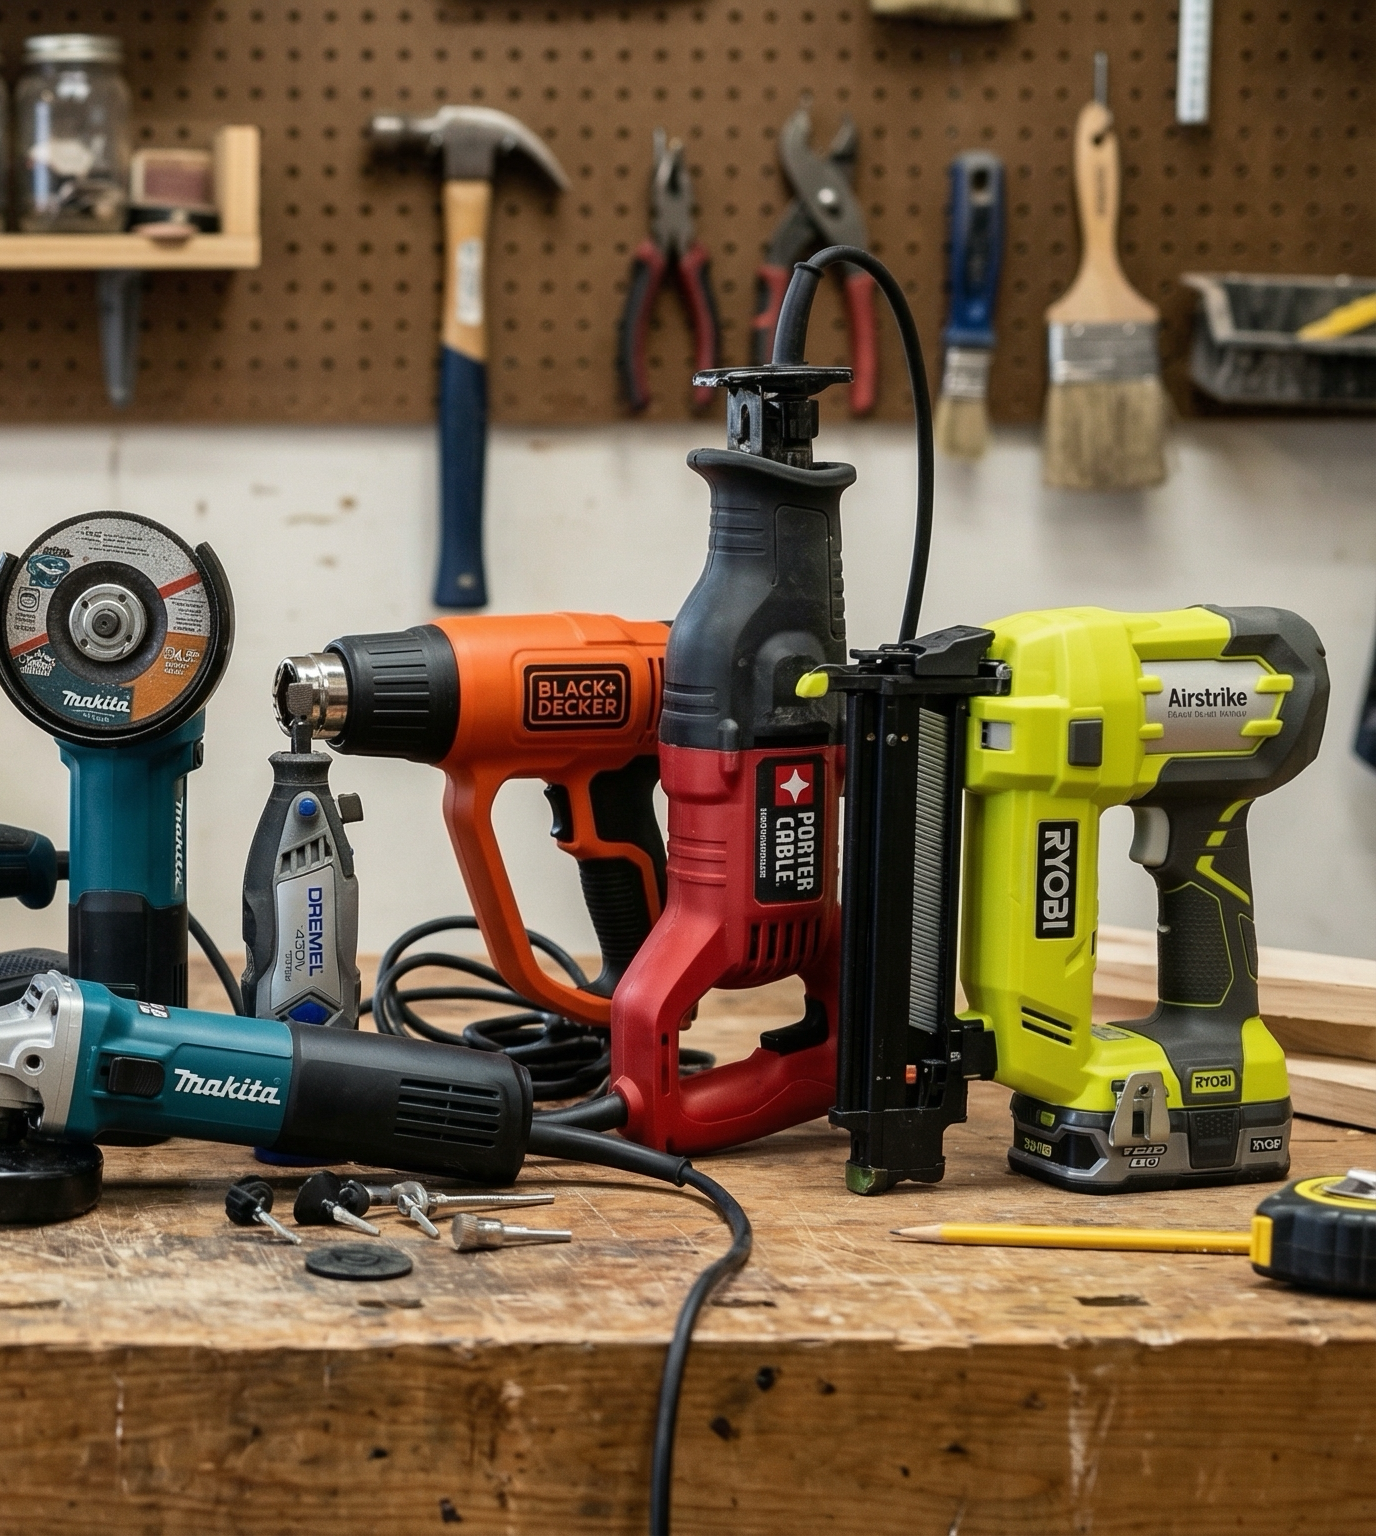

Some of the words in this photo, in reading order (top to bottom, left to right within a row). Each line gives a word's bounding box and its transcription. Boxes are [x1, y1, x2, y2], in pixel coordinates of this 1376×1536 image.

[538, 680, 617, 698] BLACK+
[1168, 687, 1248, 708] Airstrike
[538, 698, 617, 716] DECKER
[797, 811, 815, 891] PORTER
[1042, 828, 1071, 931] RYOBI
[308, 887, 324, 977] DREMEL
[174, 1068, 281, 1105] Makita
[1195, 1075, 1232, 1089] RYOBI
